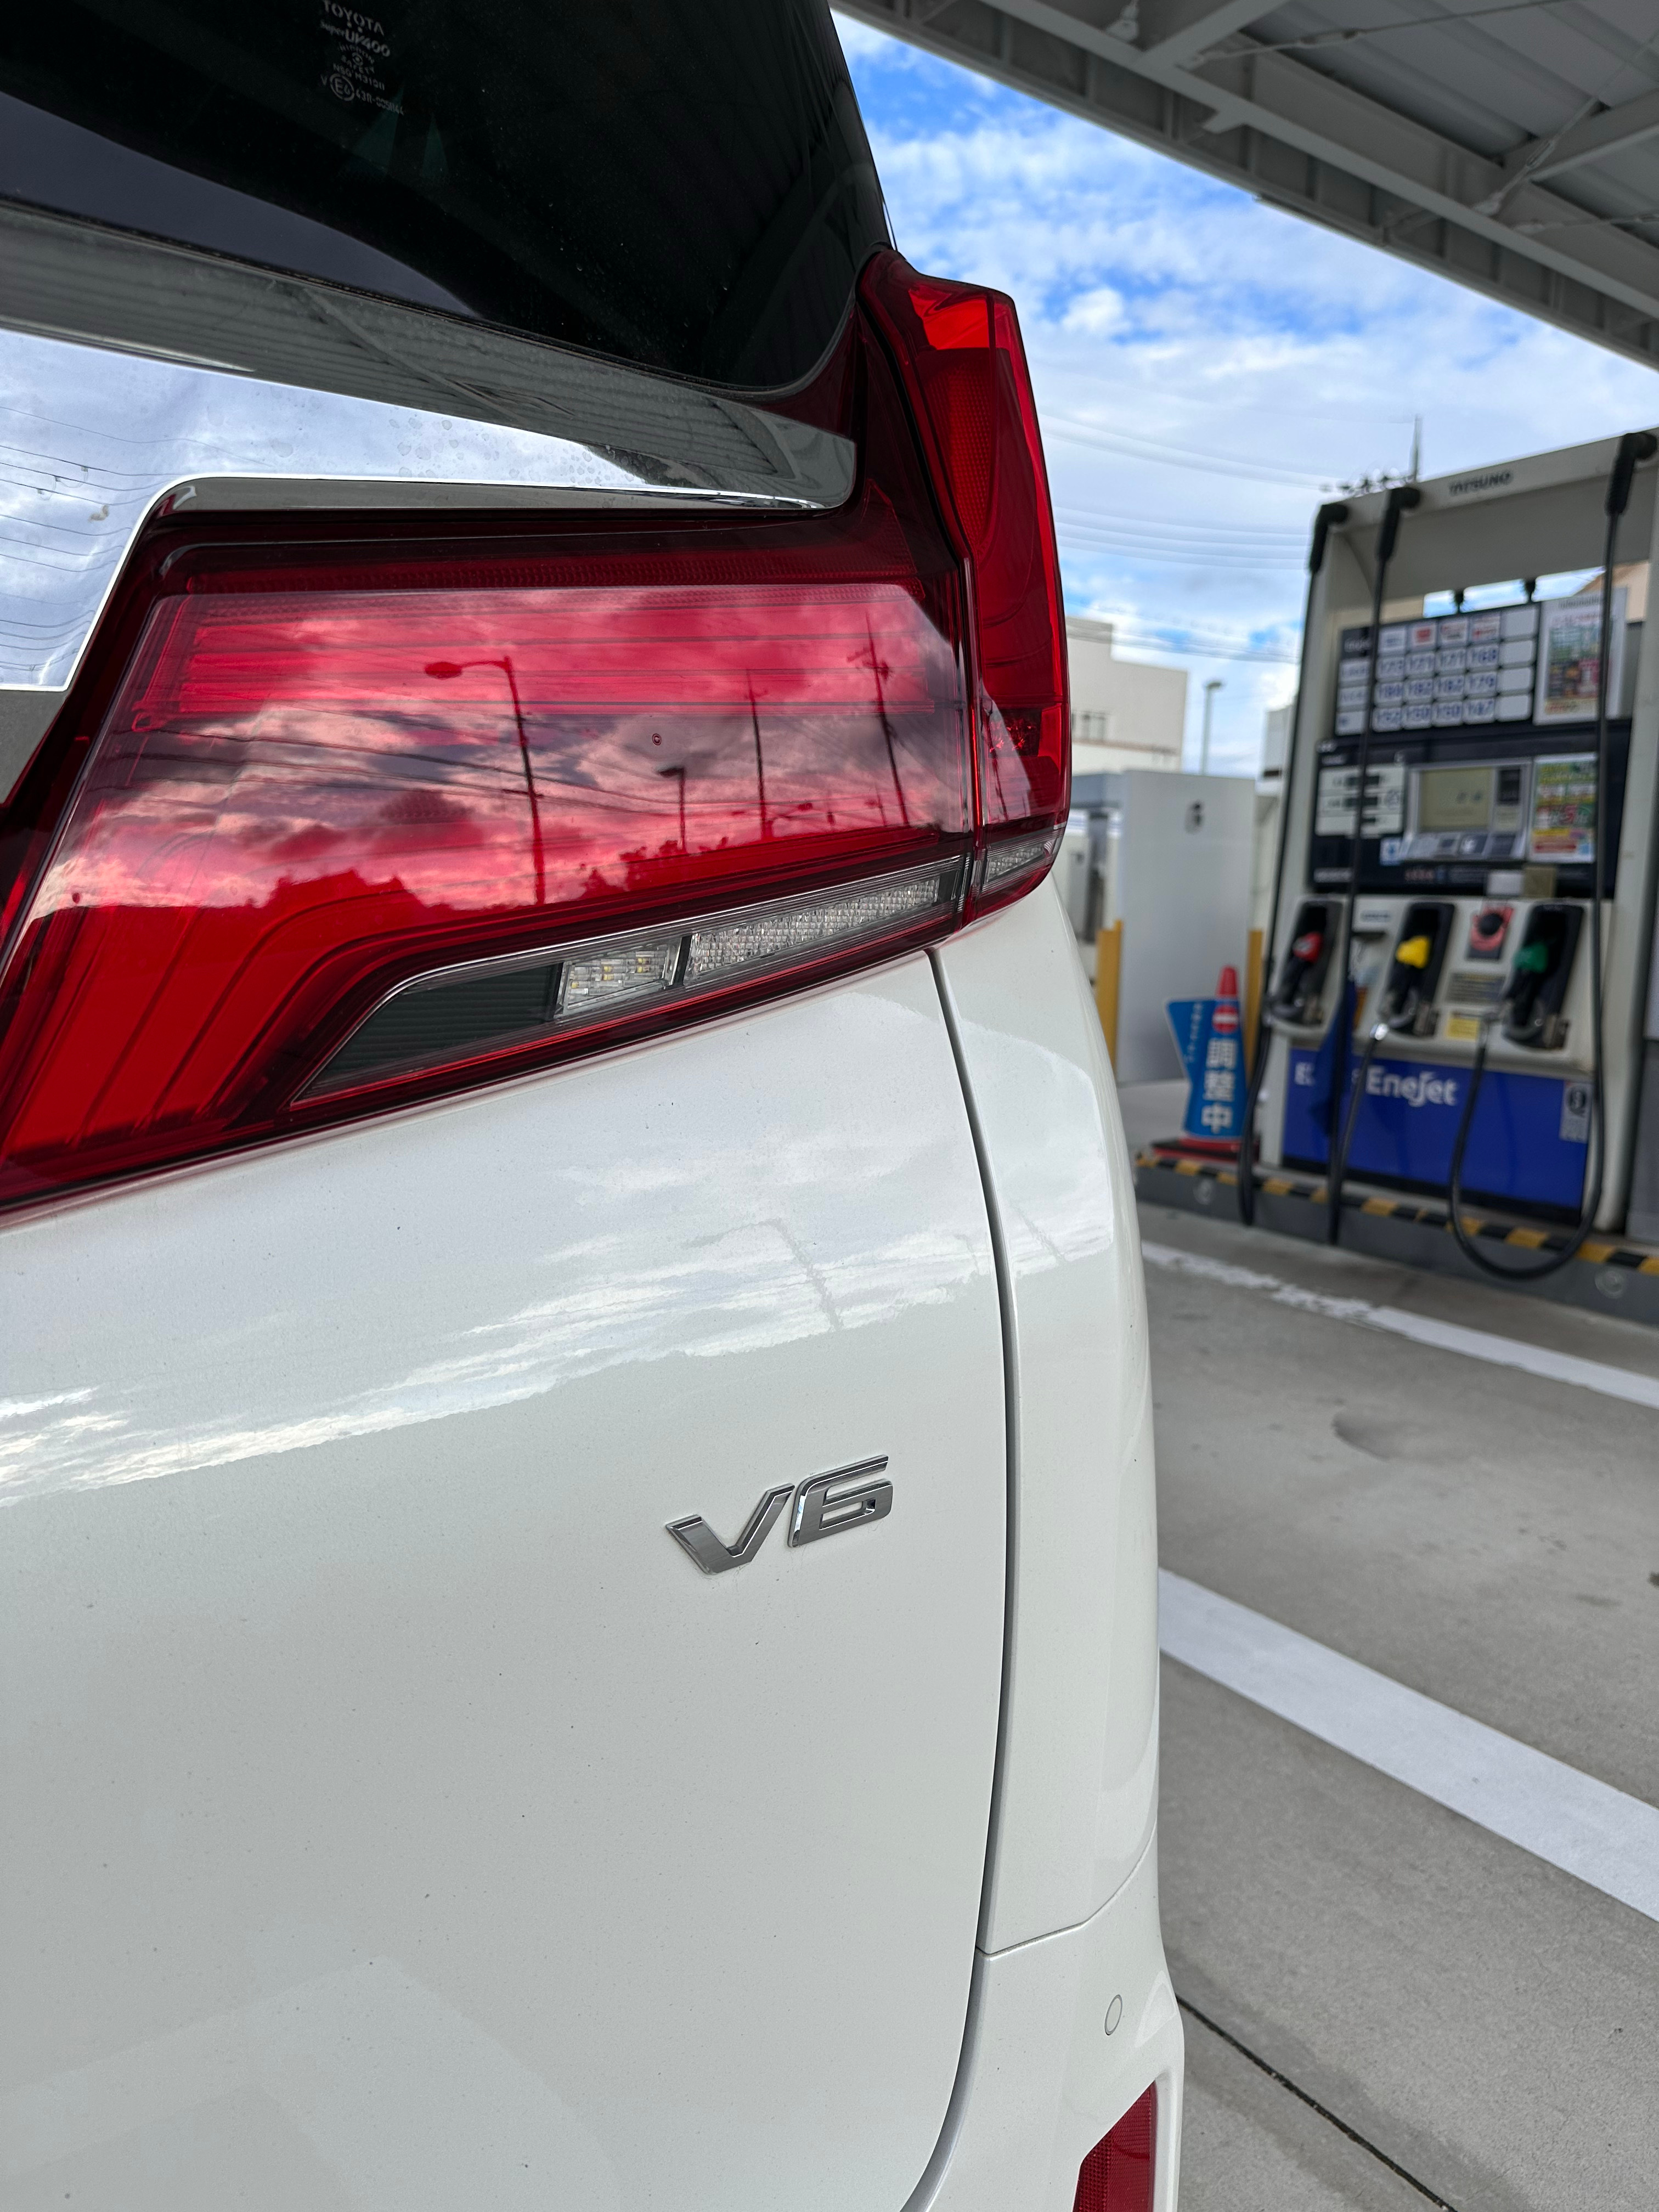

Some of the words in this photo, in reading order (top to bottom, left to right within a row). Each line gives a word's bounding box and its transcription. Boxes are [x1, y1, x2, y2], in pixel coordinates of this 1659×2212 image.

[323, 0, 385, 36] TOYOTA
[345, 29, 390, 57] UV400
[665, 1453, 893, 1575] V6
